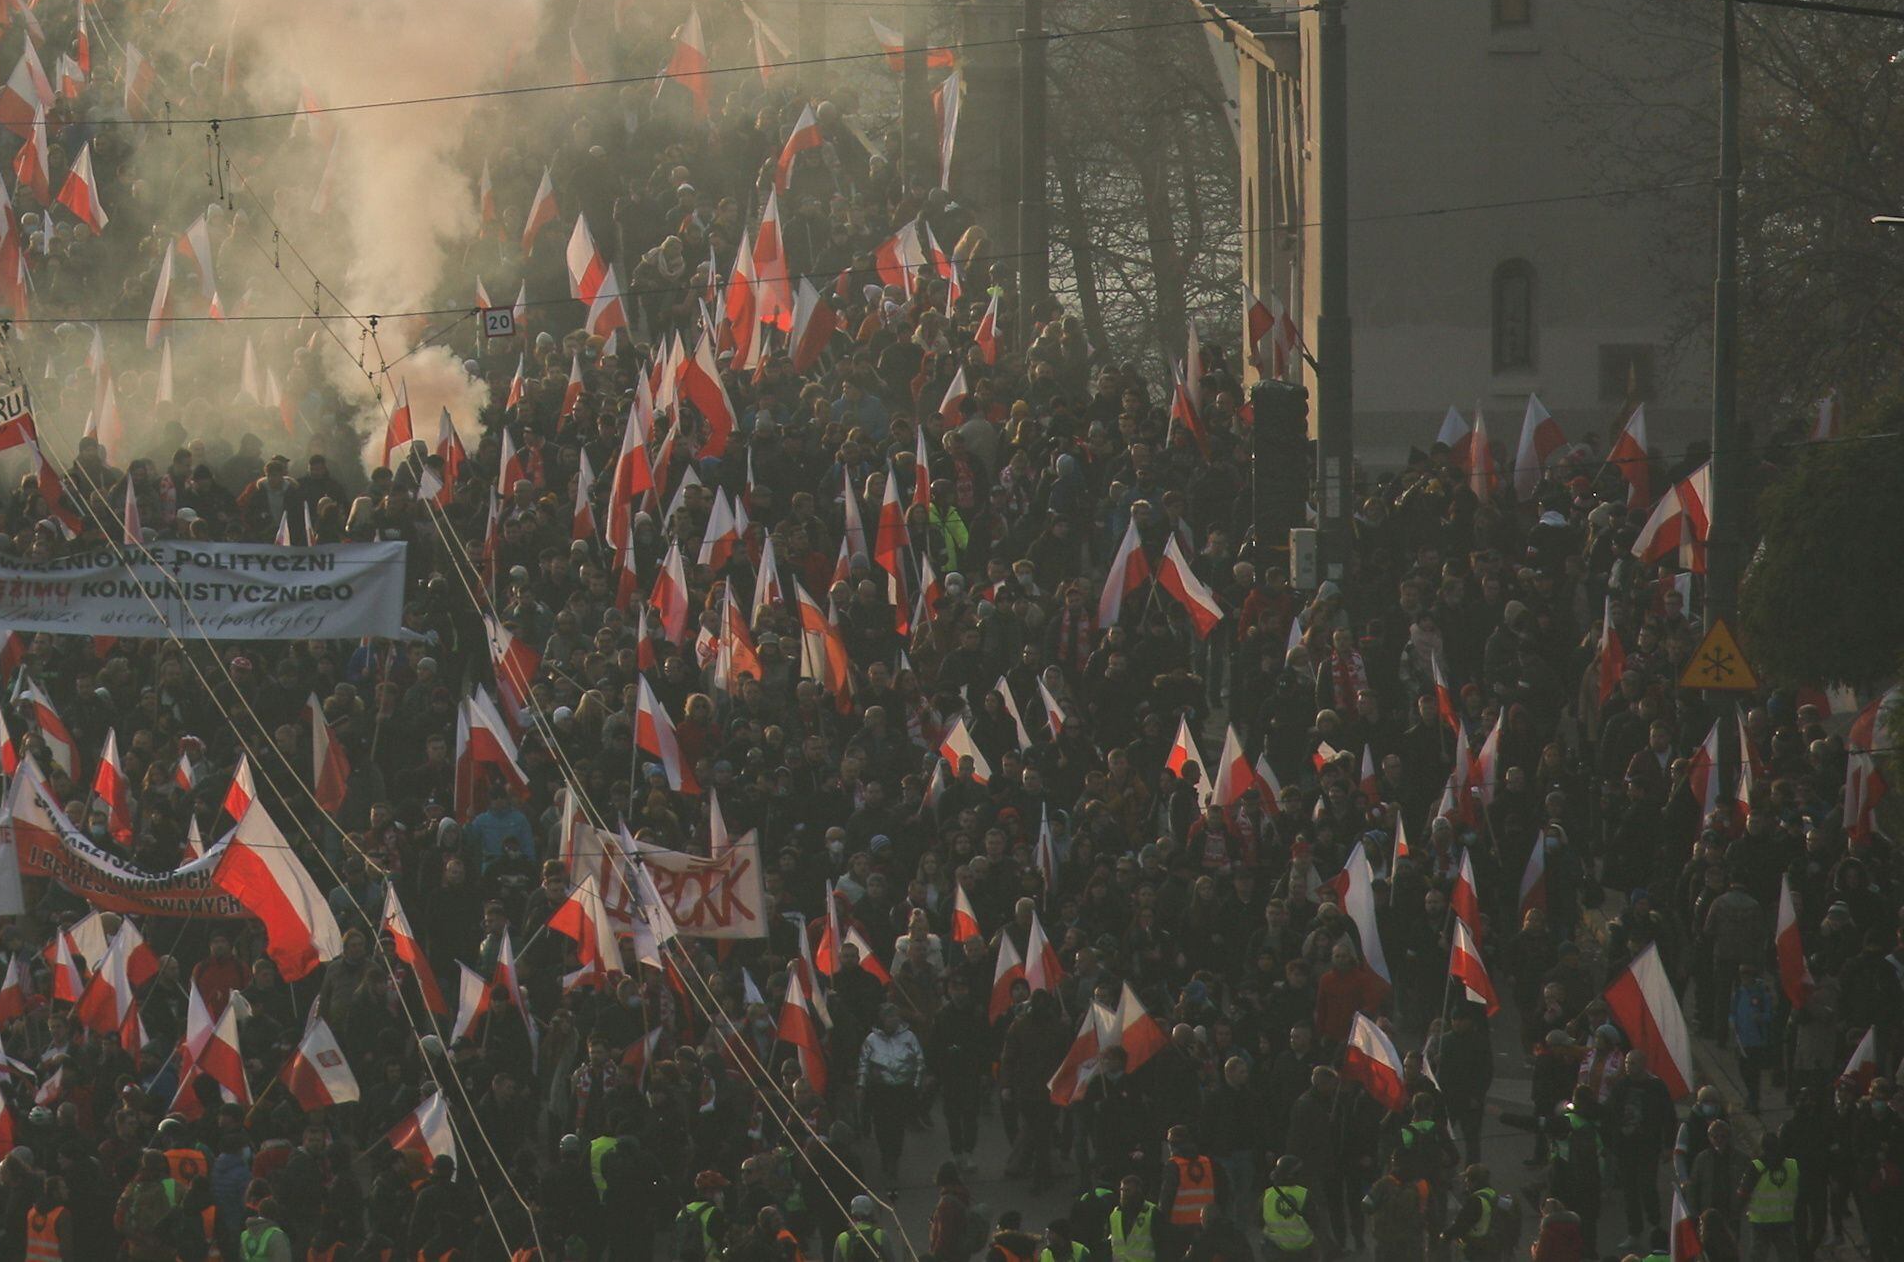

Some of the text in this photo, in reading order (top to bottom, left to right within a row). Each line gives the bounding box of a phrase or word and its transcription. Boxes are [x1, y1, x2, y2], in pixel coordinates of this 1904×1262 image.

[488, 314, 510, 330] 20
[176, 549, 336, 572] POLITYCZNI
[81, 580, 354, 603] KOMUNISTYCZNEGO
